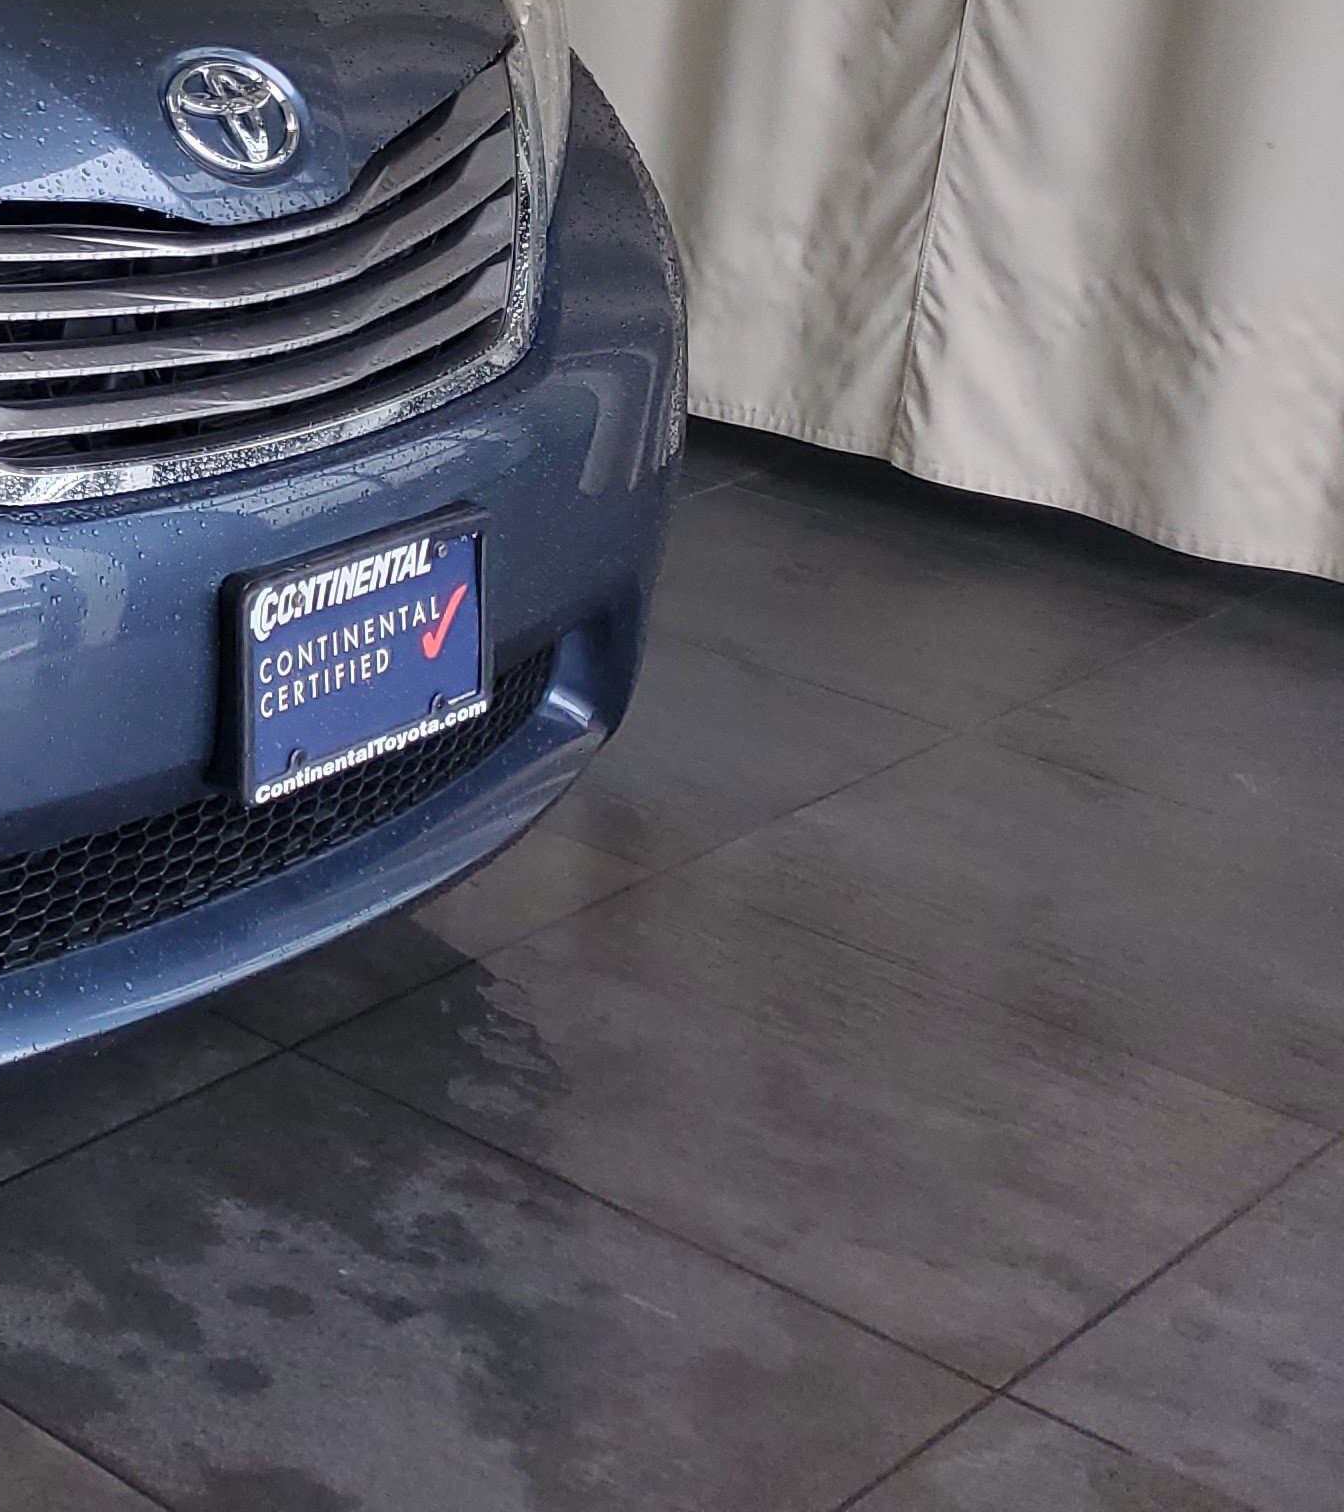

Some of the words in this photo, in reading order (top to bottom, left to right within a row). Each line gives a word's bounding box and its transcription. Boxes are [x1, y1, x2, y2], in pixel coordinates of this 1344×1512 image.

[260, 595, 440, 684] CONTINENTAL
[260, 648, 391, 718] CERTIFIED
[255, 699, 487, 804] ContinentalToyota.com
